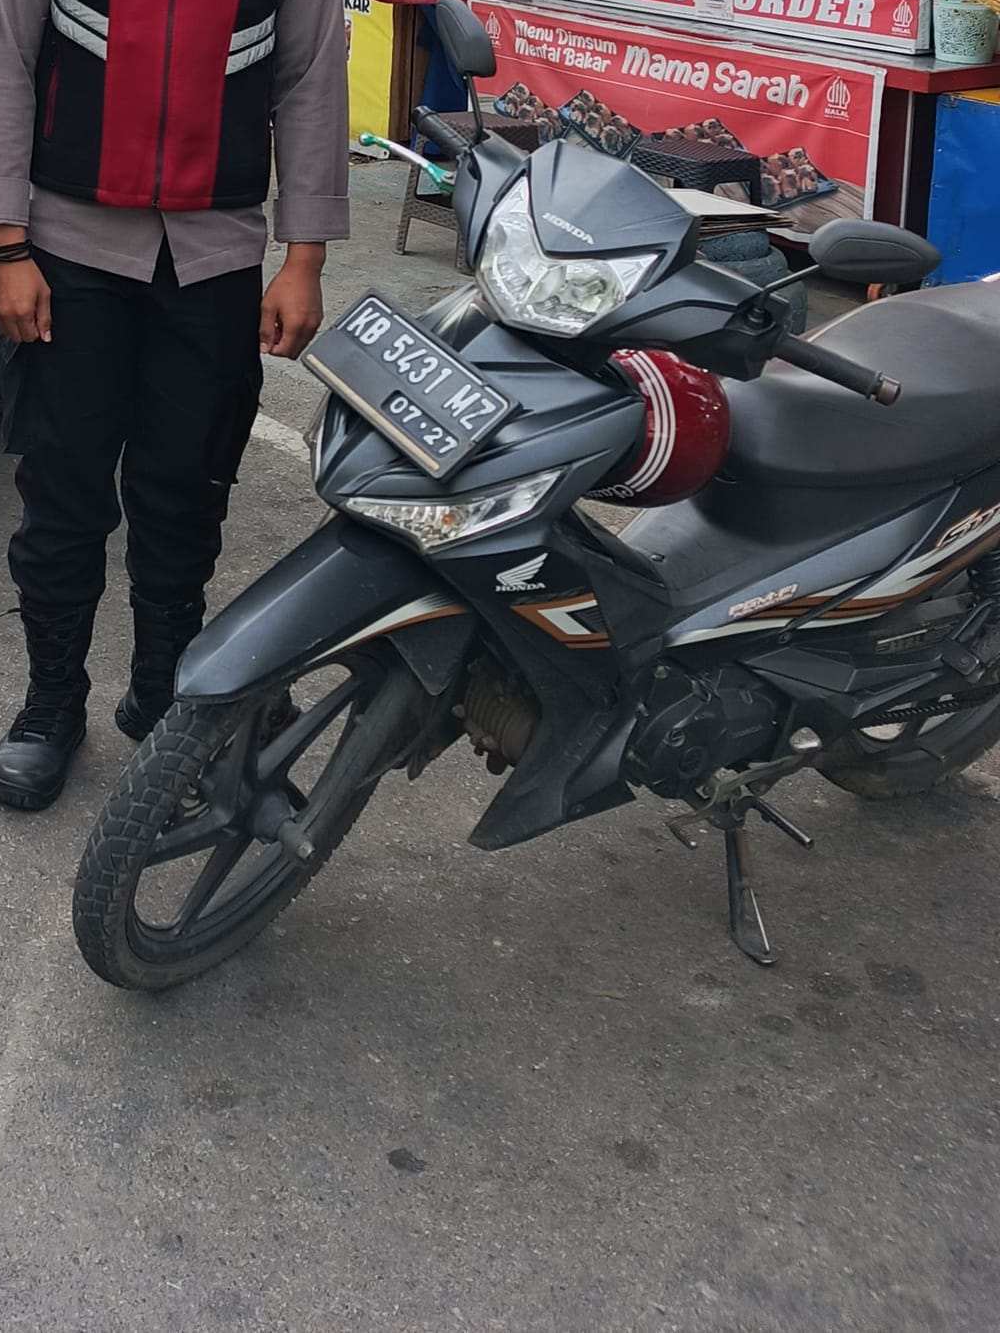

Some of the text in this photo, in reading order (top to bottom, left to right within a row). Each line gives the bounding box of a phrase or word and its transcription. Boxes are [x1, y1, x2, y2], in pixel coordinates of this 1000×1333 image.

[514, 19, 617, 56] Menu Dimsum
[514, 37, 612, 74] Mentai Bakar
[621, 44, 809, 108] Mama Sarah
[824, 108, 849, 118] HALAL
[542, 212, 595, 245] HONDA
[346, 307, 497, 431] KB 5431 MZ
[495, 581, 547, 592] HONDA
